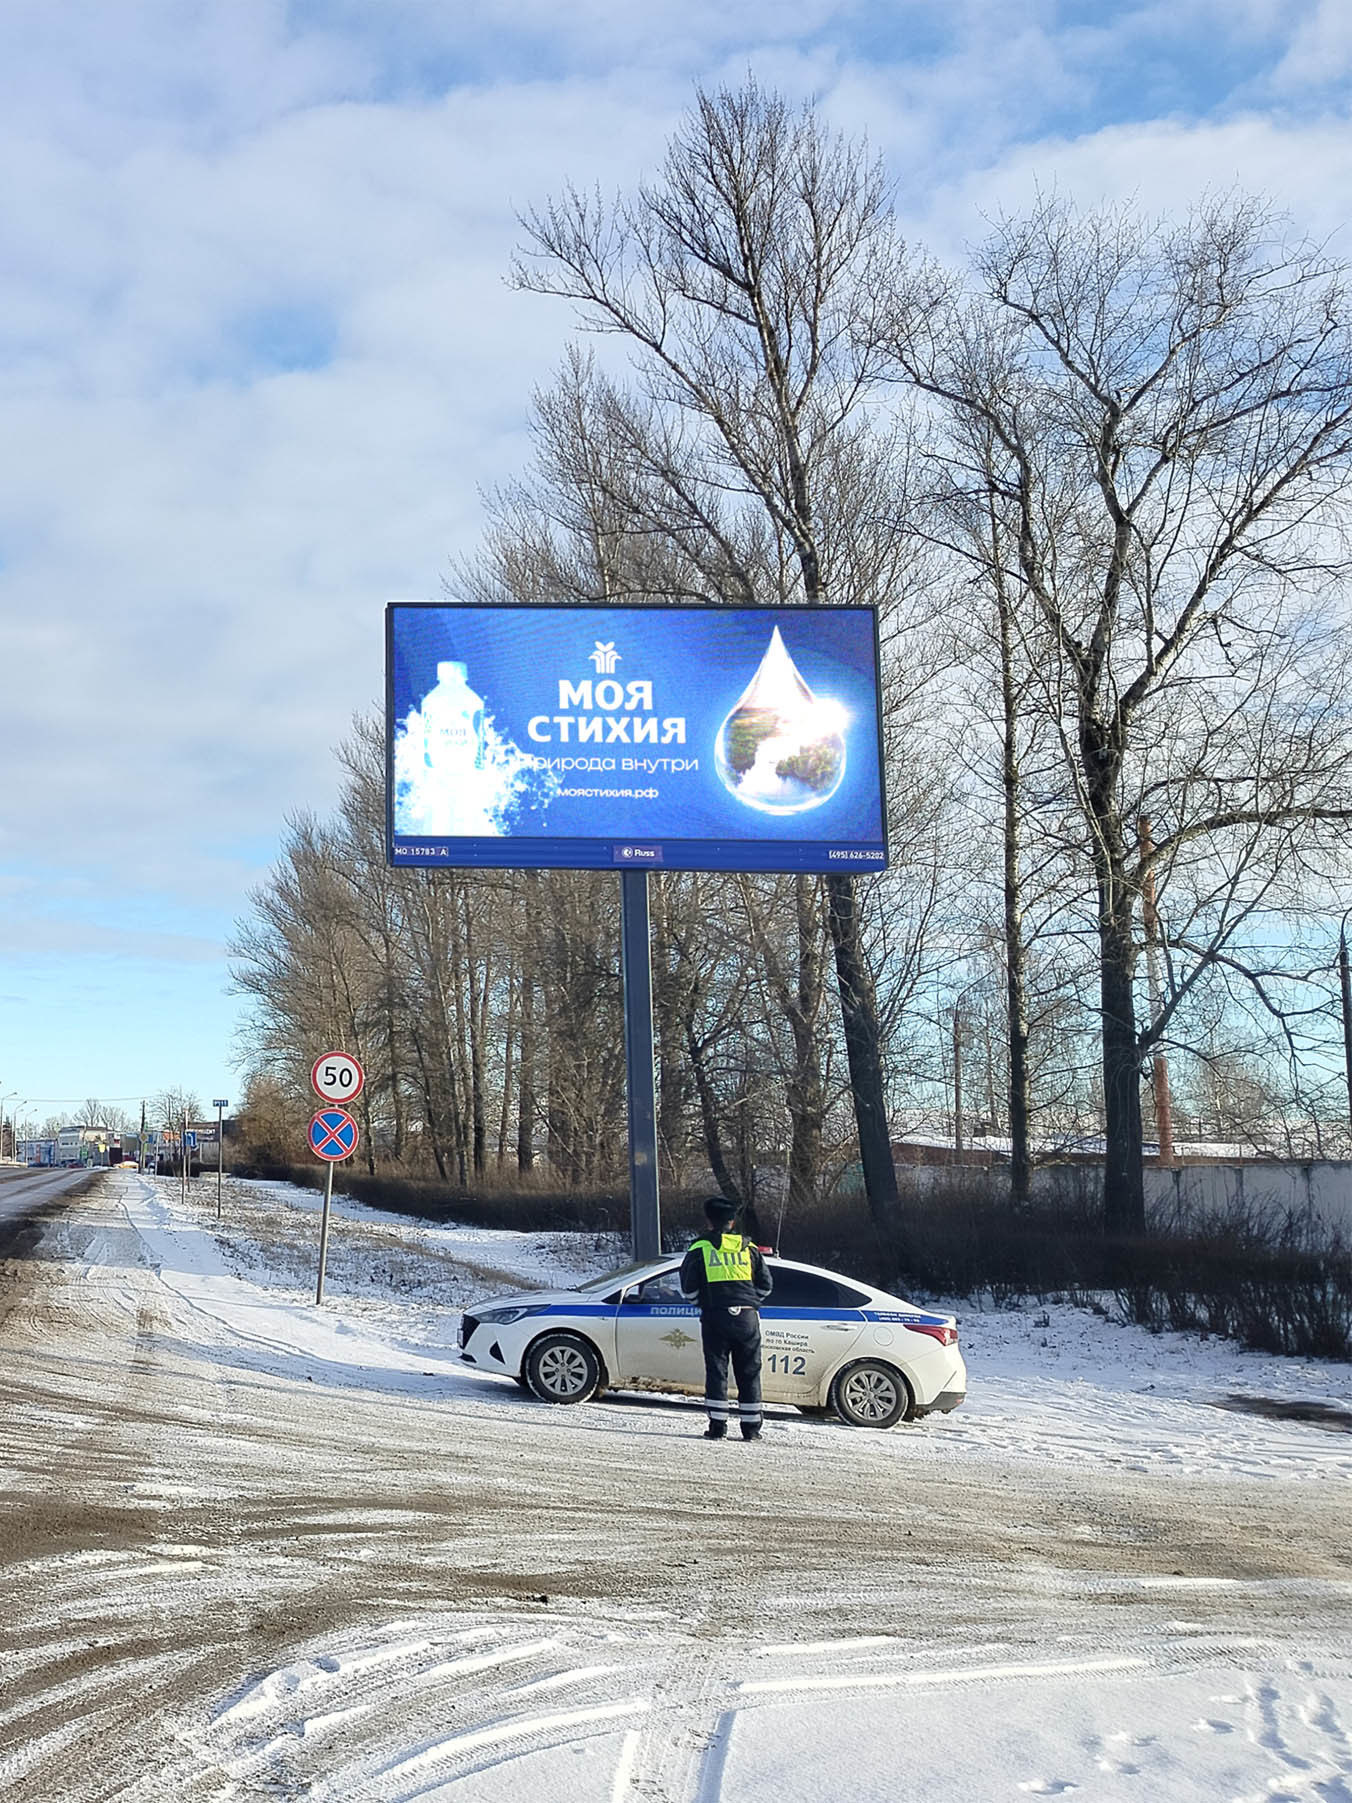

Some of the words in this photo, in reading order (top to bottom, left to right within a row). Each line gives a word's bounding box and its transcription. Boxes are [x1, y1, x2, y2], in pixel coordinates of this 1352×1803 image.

[559, 679, 653, 711] МОЯ
[527, 715, 687, 744] СТИХИЯ
[621, 758, 699, 773] внутри
[557, 787, 659, 799] моястихия.рф
[634, 848, 655, 857] Russ
[323, 1066, 353, 1088] 50
[650, 1306, 703, 1316] ПОЛИЦИ
[767, 1354, 806, 1376] 112
